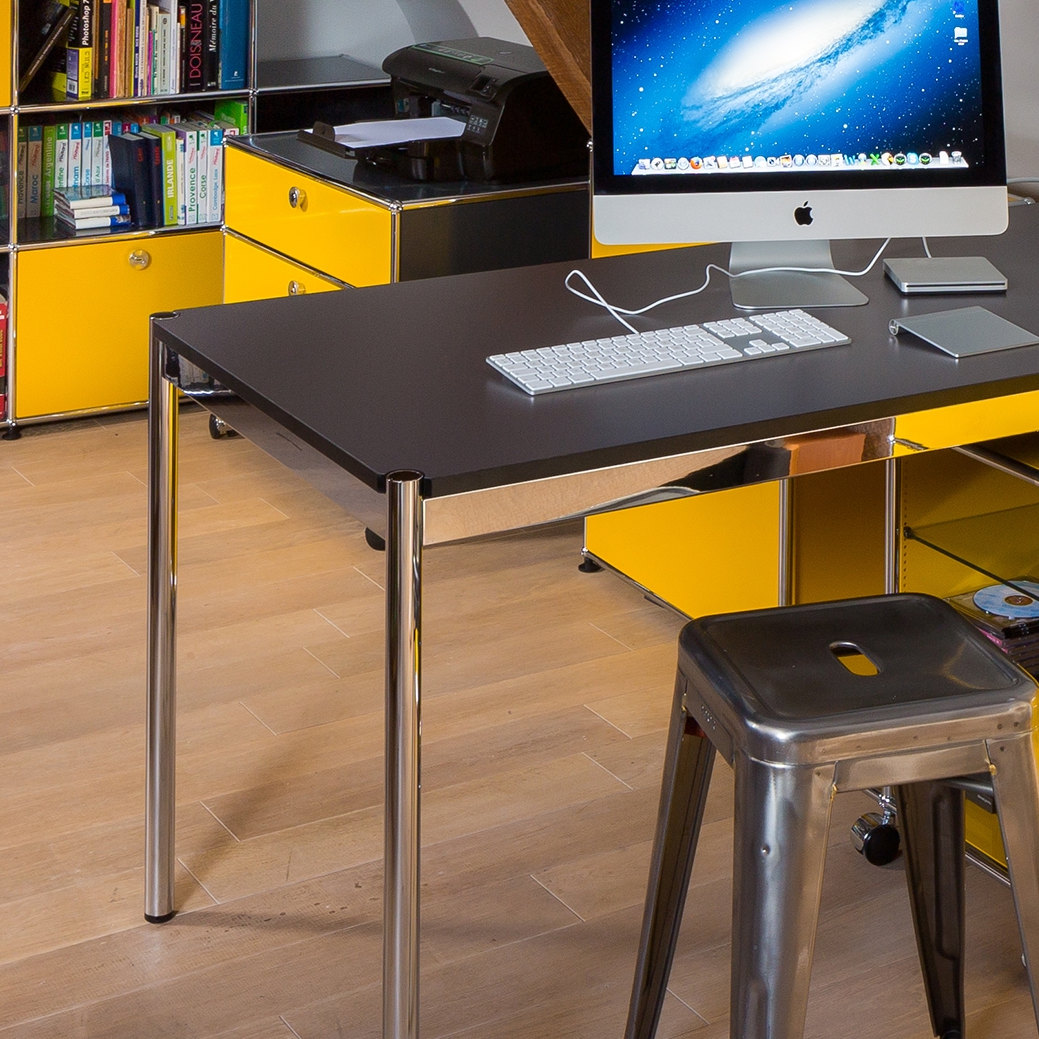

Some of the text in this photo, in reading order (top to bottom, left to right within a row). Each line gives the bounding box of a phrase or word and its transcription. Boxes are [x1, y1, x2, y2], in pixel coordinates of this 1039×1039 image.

[82, 5, 91, 46] Photoshop
[209, 5, 217, 15] du
[189, 3, 203, 78] DOISNEAU
[209, 17, 217, 52] Mémoire
[44, 137, 53, 177] Argentine
[30, 174, 38, 204] Maroc
[166, 159, 174, 198] IRLANDE
[188, 168, 196, 211] Provence
